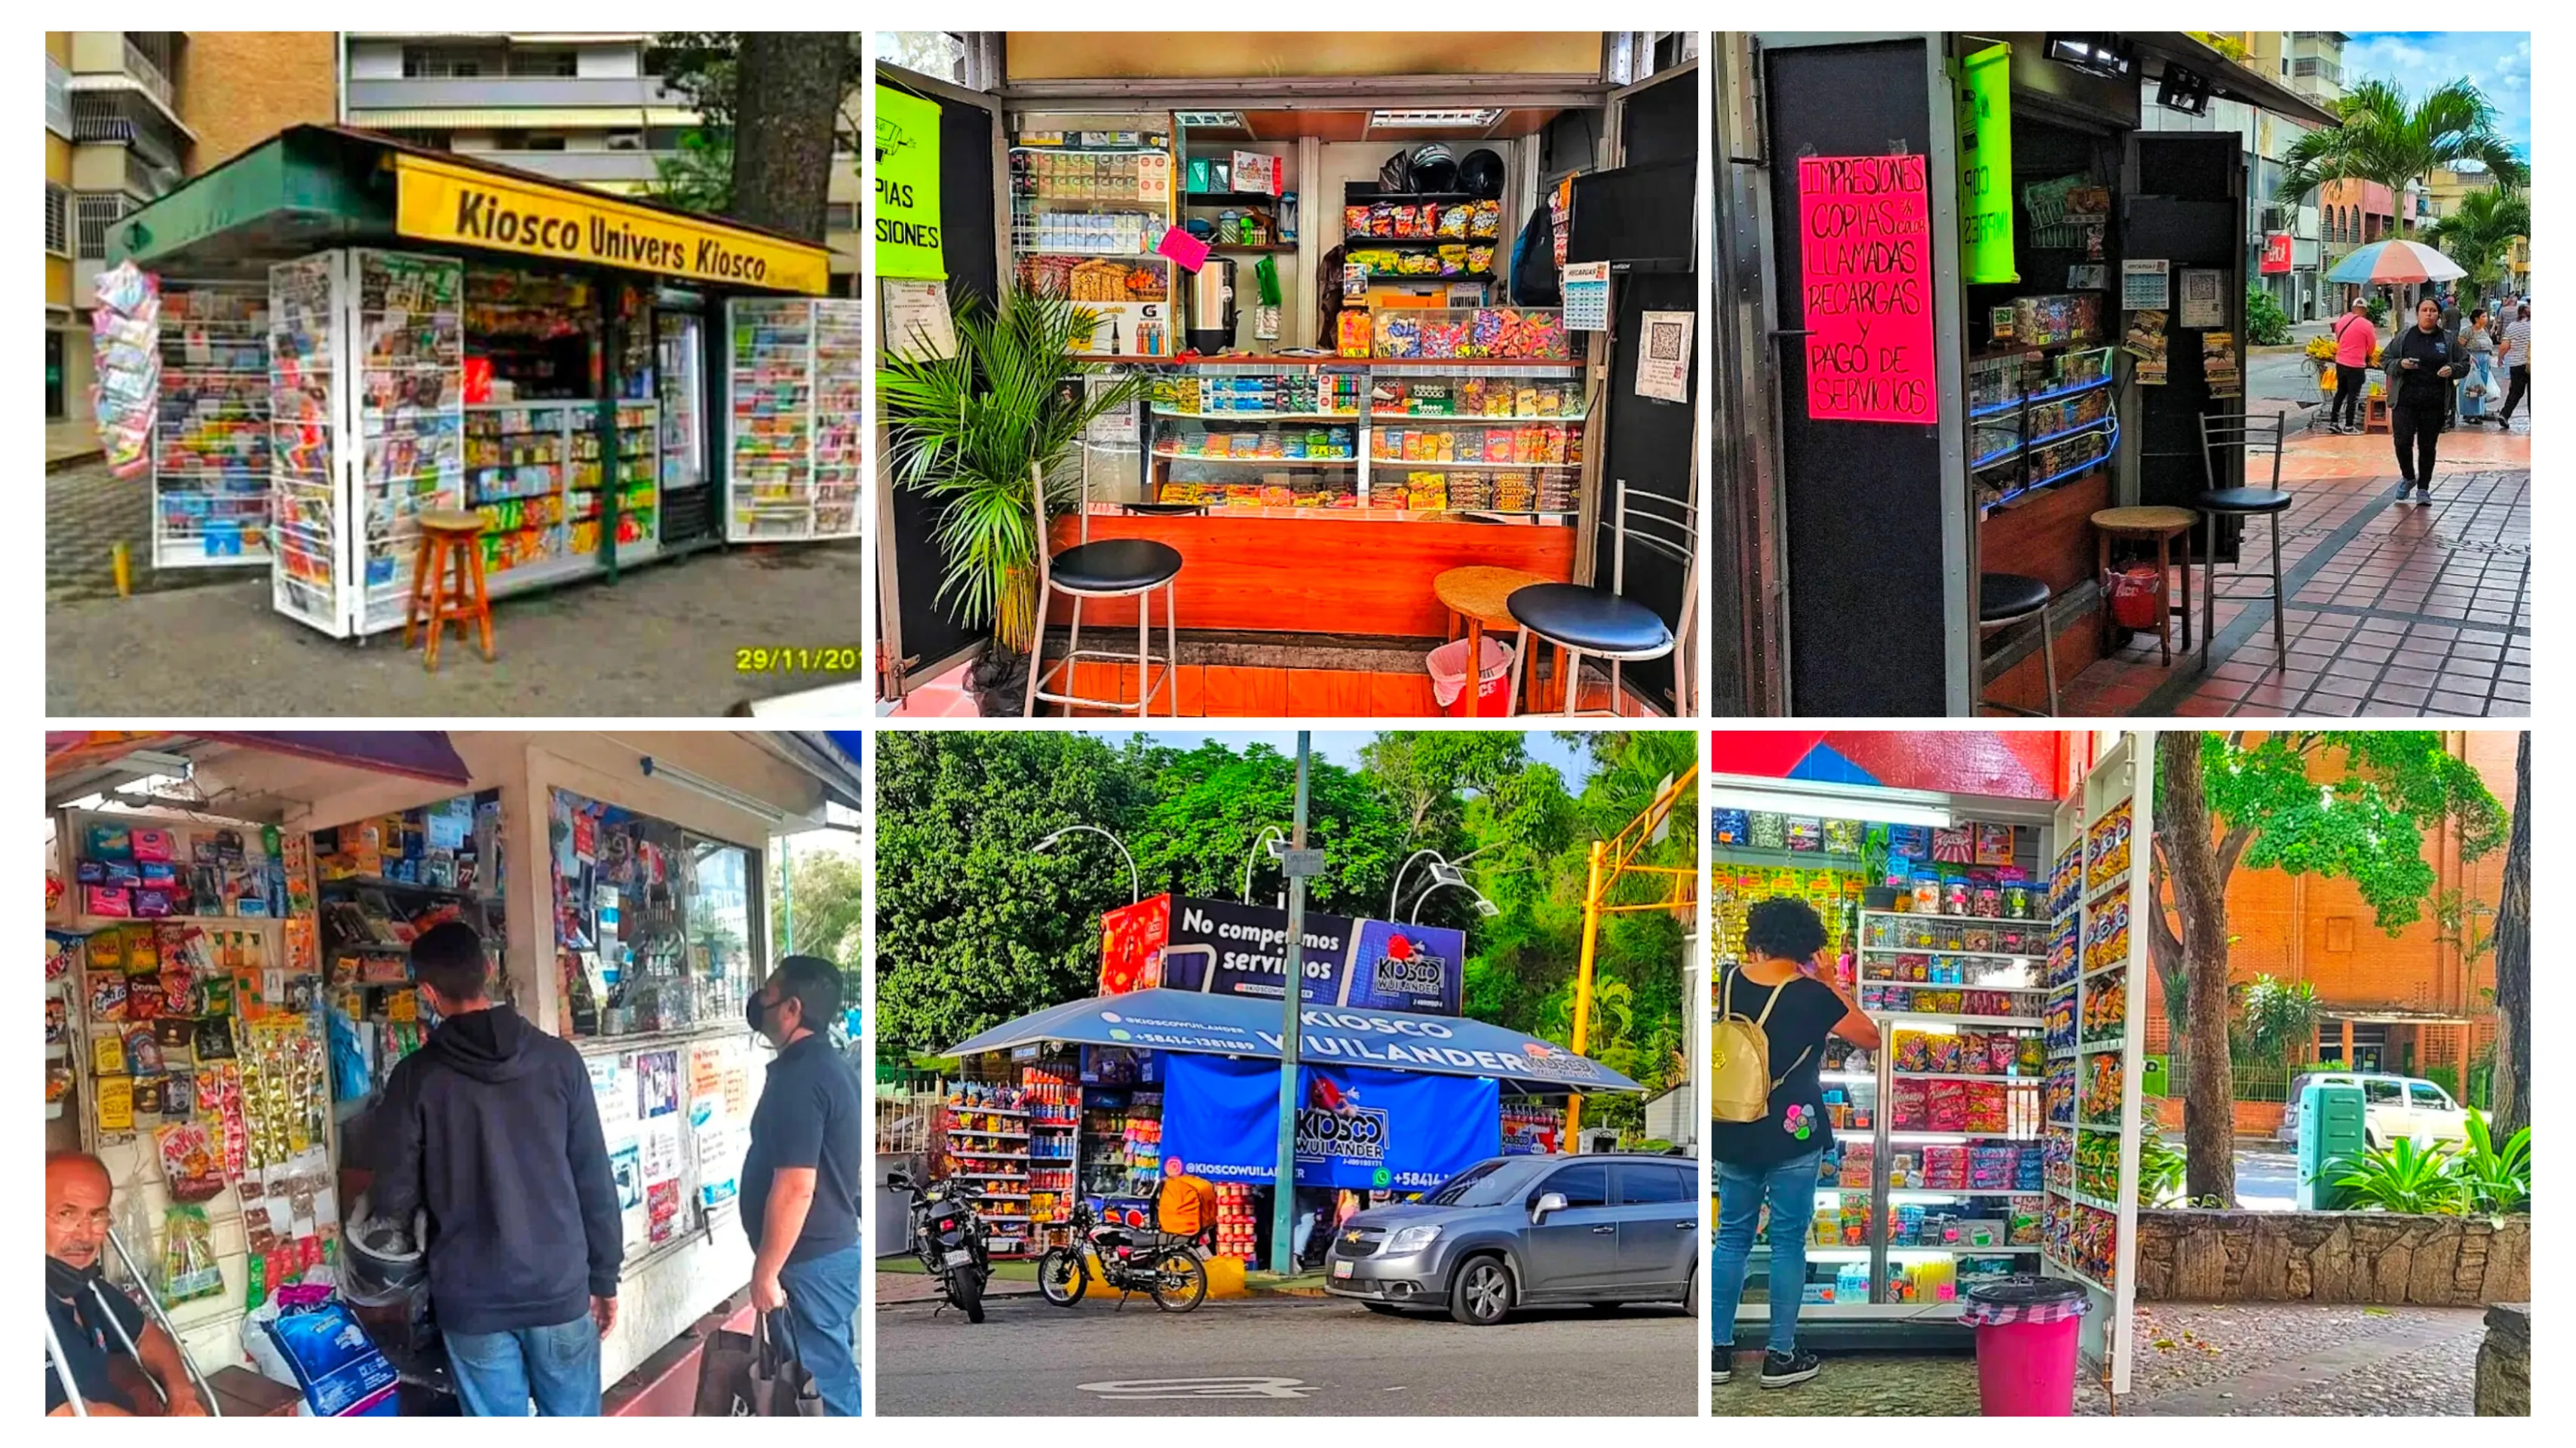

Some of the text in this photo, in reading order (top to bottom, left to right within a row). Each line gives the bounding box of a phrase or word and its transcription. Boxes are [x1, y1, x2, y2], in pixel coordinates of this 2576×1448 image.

[1802, 156, 1924, 195] IMPRESIONES
[455, 189, 767, 282] Kiosco Univers Kiosco
[876, 218, 939, 249] SIONES
[1811, 200, 1895, 238] COPIAS
[1808, 240, 1918, 276] LLAMADAS
[1808, 279, 1921, 315] RECARGAS
[1811, 342, 1909, 374] PAGO DE
[1814, 376, 1927, 415] SERVICIOS
[1182, 907, 1213, 934] No
[1218, 922, 1340, 951] compemos
[1378, 957, 1440, 984] KIOSCO
[1378, 980, 1440, 995] WUILANDER
[1124, 1016, 1246, 1035] @KIOSCOWUILANDER
[1300, 1011, 1454, 1039] KIOSCO
[1296, 1109, 1383, 1144] KIOSCO
[1296, 1137, 1385, 1158] WUILANDER
[1185, 1164, 1305, 1179] @KIOSCOWUILAR
